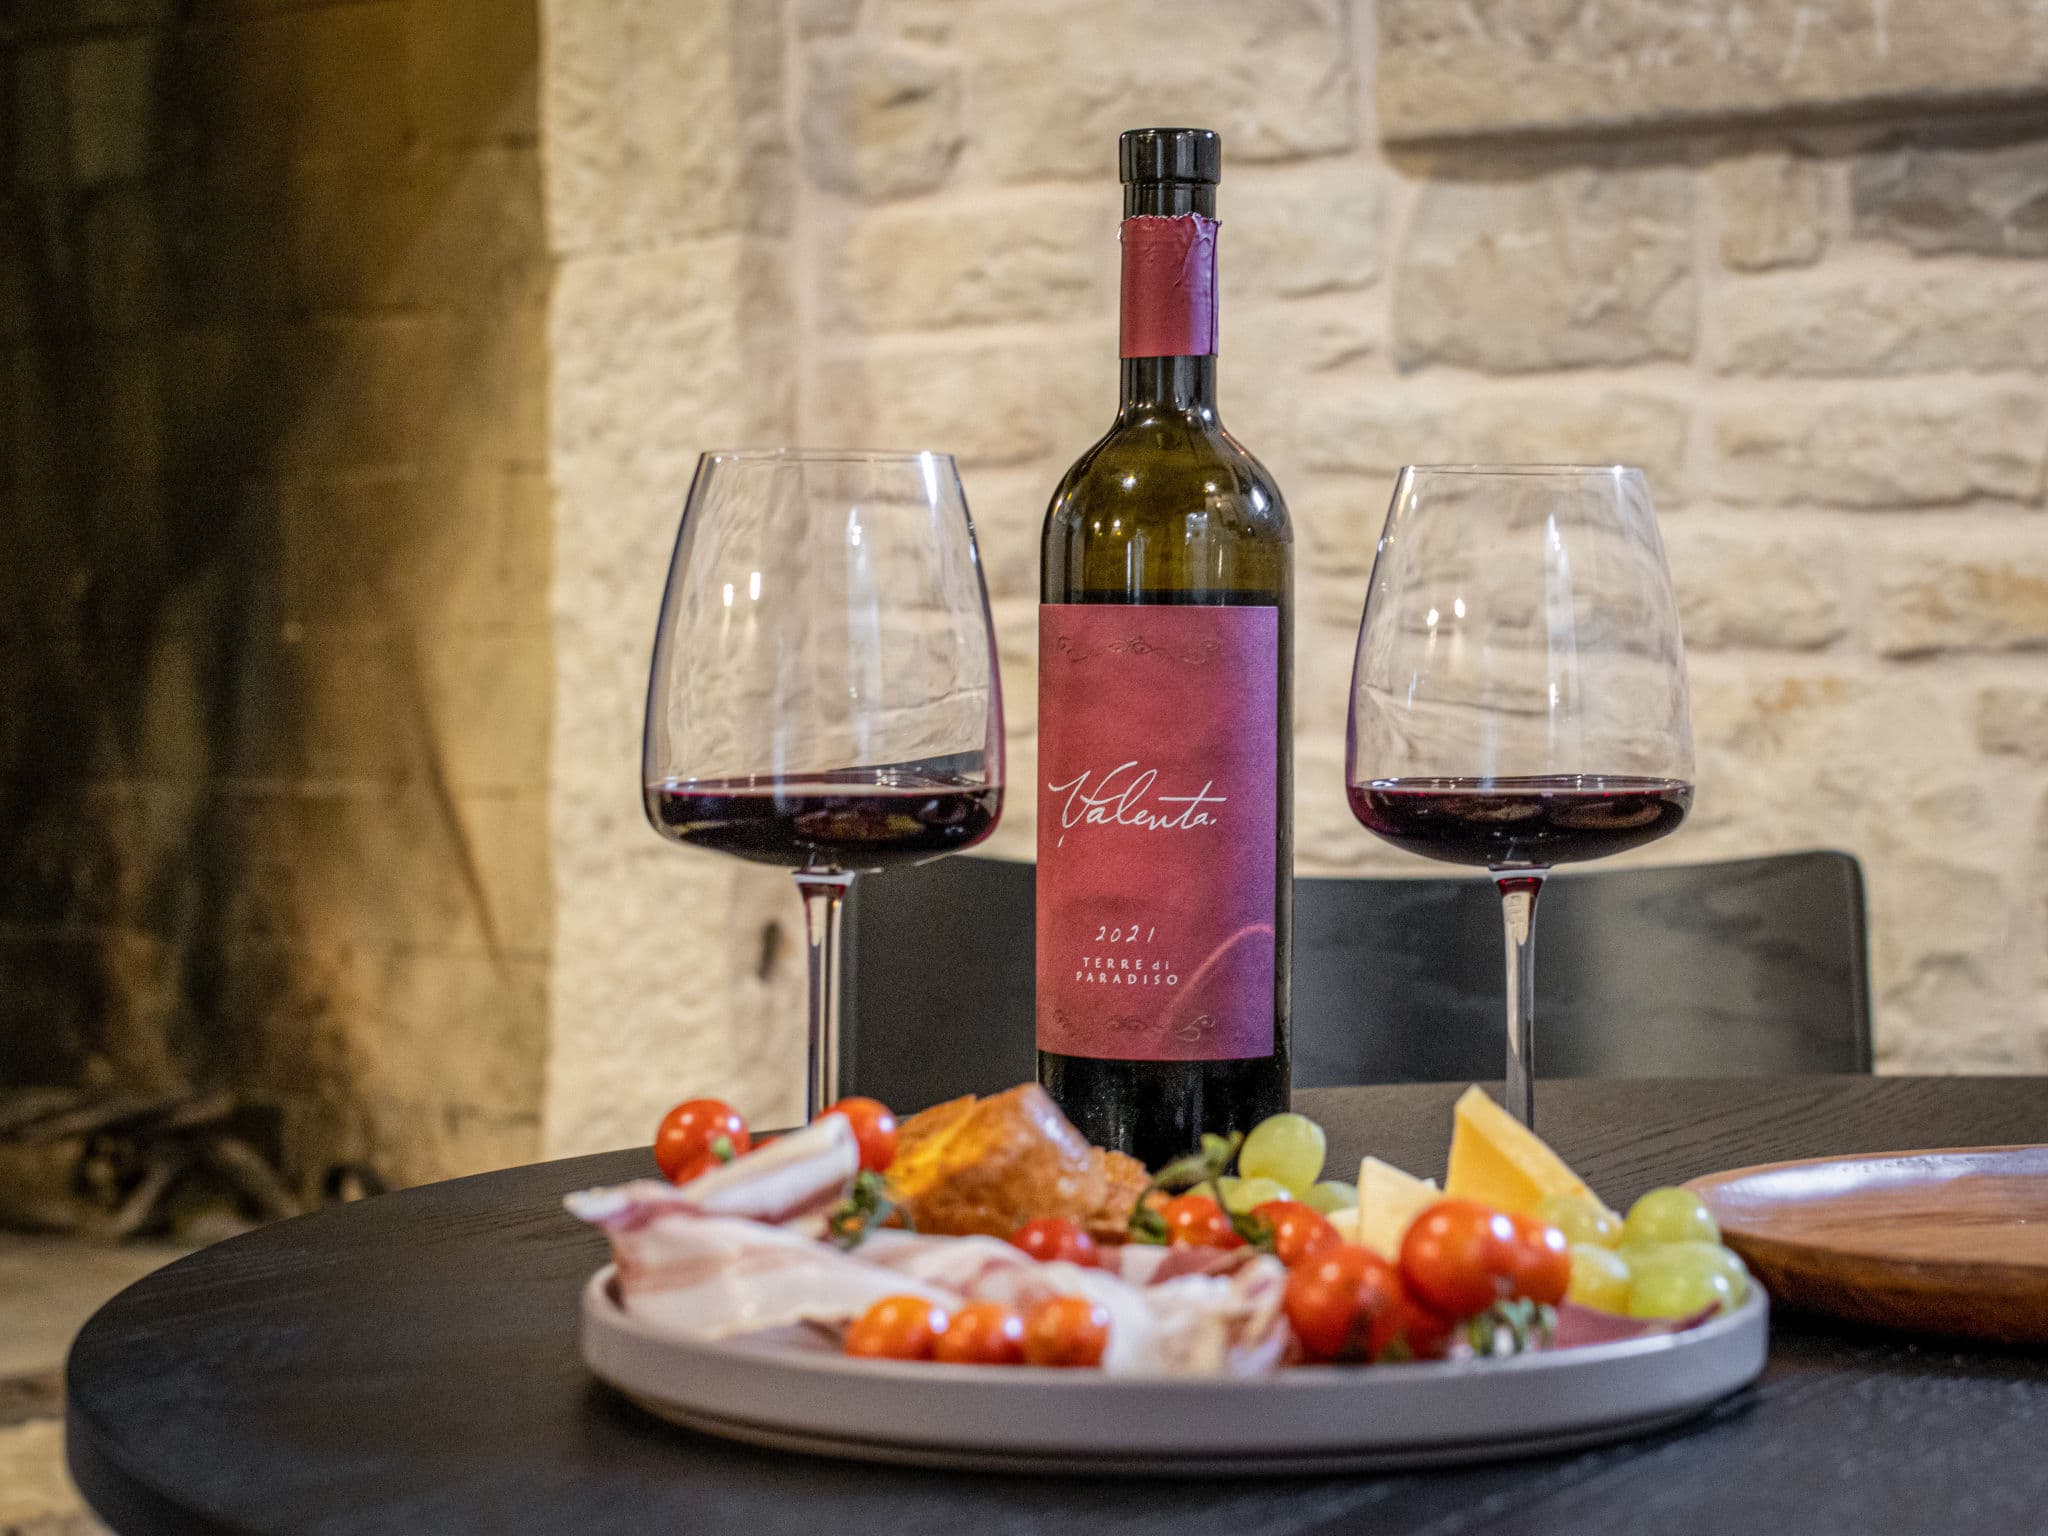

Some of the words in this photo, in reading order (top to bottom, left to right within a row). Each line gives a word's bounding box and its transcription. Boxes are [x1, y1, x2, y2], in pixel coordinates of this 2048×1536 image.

[1095, 924, 1156, 943] 2021
[1082, 956, 1143, 971] TERRE
[1152, 960, 1170, 970] di
[1076, 971, 1179, 986] PARADISO
